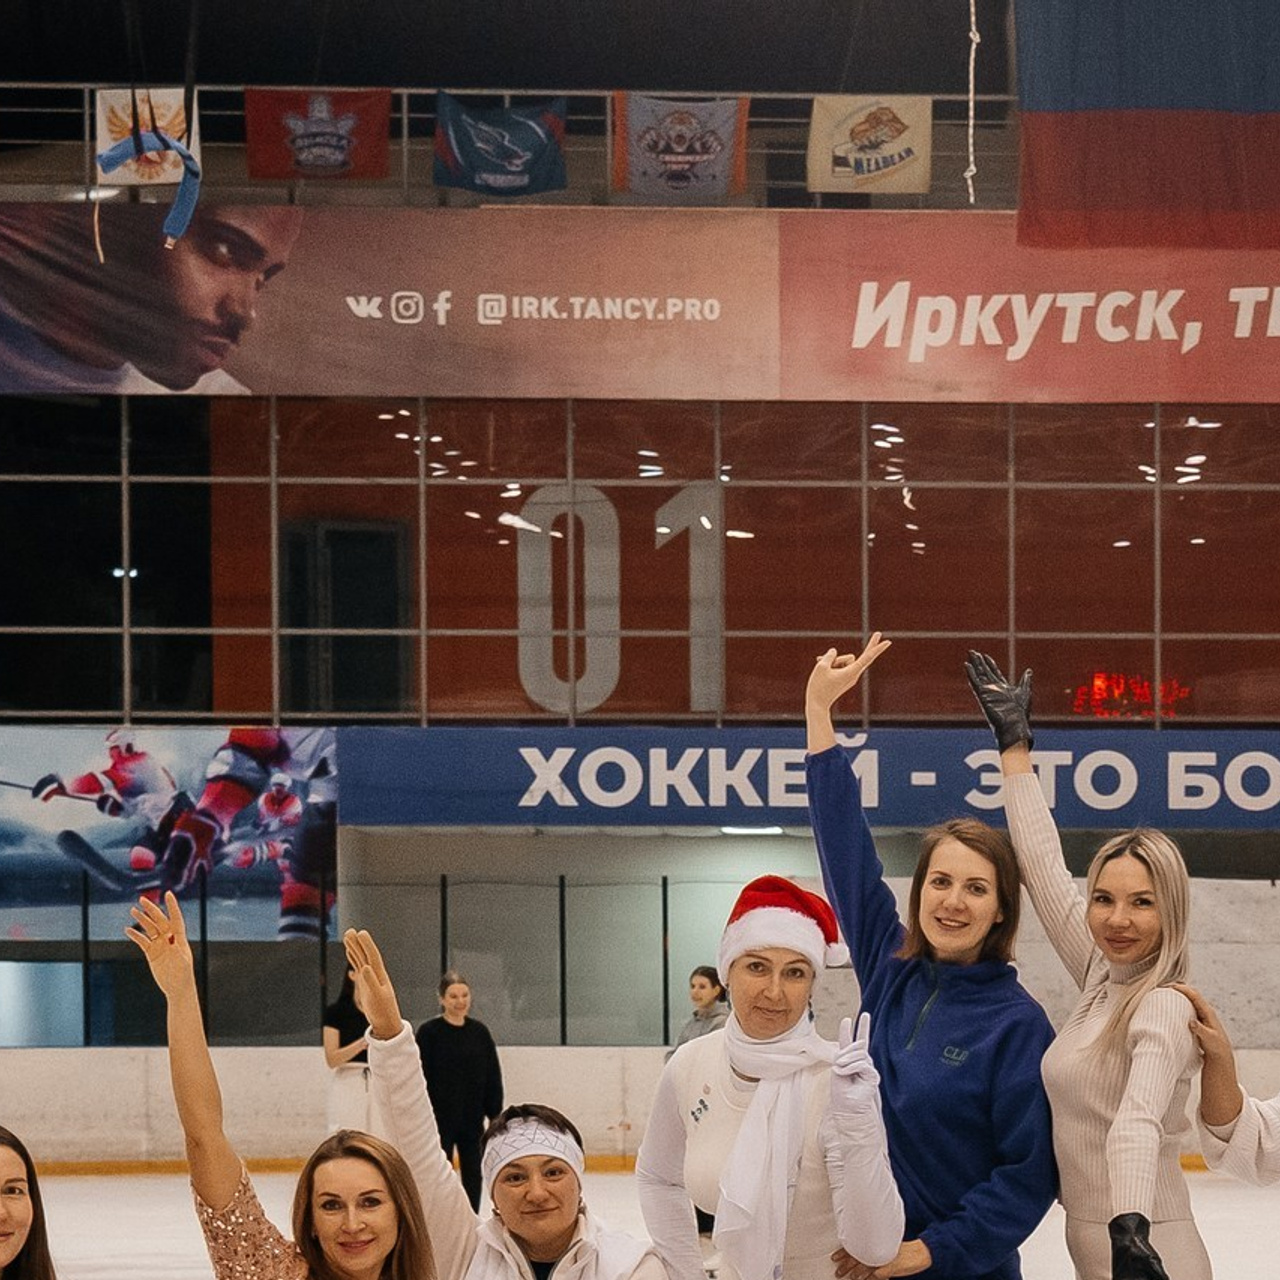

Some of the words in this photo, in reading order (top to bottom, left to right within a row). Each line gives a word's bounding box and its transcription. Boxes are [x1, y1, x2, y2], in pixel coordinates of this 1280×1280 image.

[477, 293, 721, 326] @IRK.TANCY.PRO
[851, 280, 1203, 363] Иркутск,
[517, 482, 727, 714] 01
